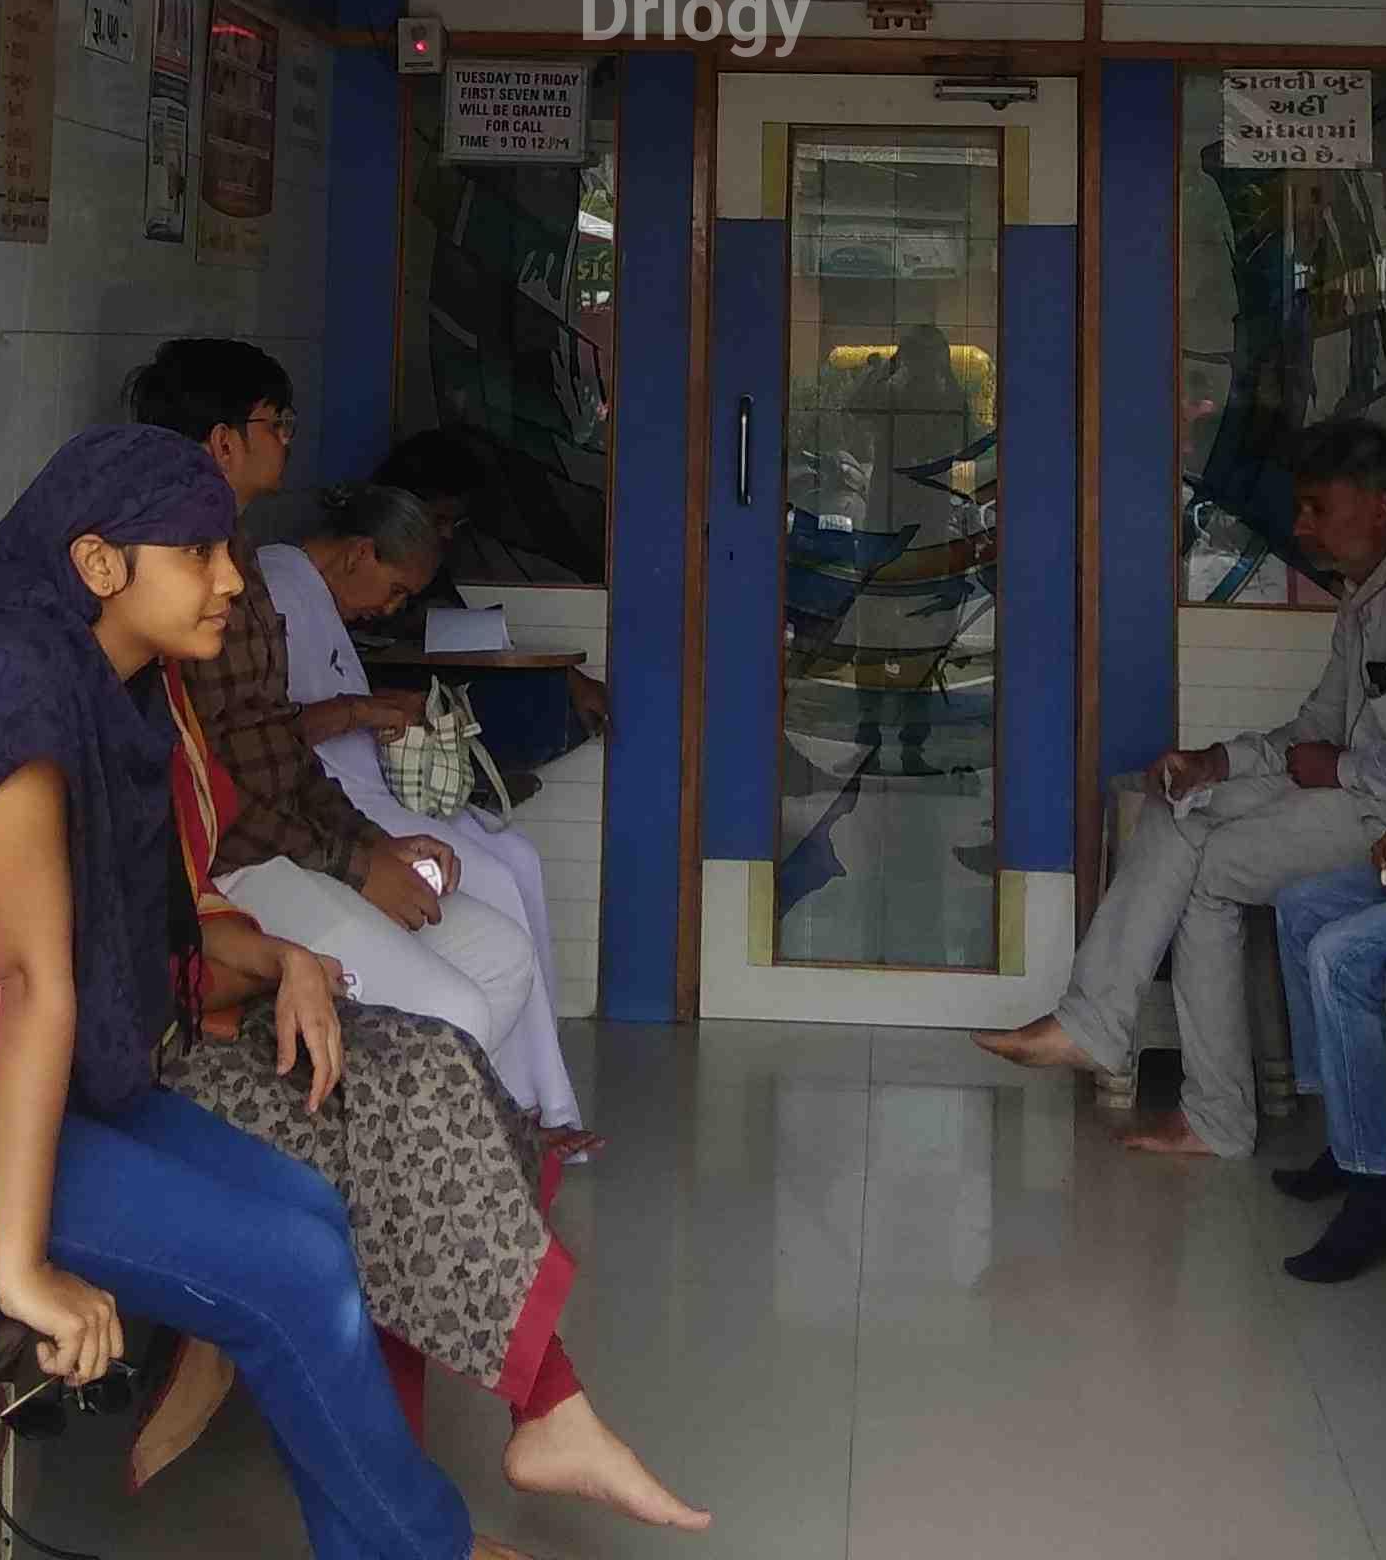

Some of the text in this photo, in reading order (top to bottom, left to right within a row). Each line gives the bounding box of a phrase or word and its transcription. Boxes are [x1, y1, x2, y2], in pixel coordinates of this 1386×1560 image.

[455, 71, 580, 86] TUESDAY TO FRIDAY
[460, 87, 495, 100] FIRST
[499, 88, 540, 101] SEVEN
[459, 103, 572, 118] WILL BE GRANTED
[485, 119, 543, 133] FOR CALL
[512, 136, 527, 149] TO
